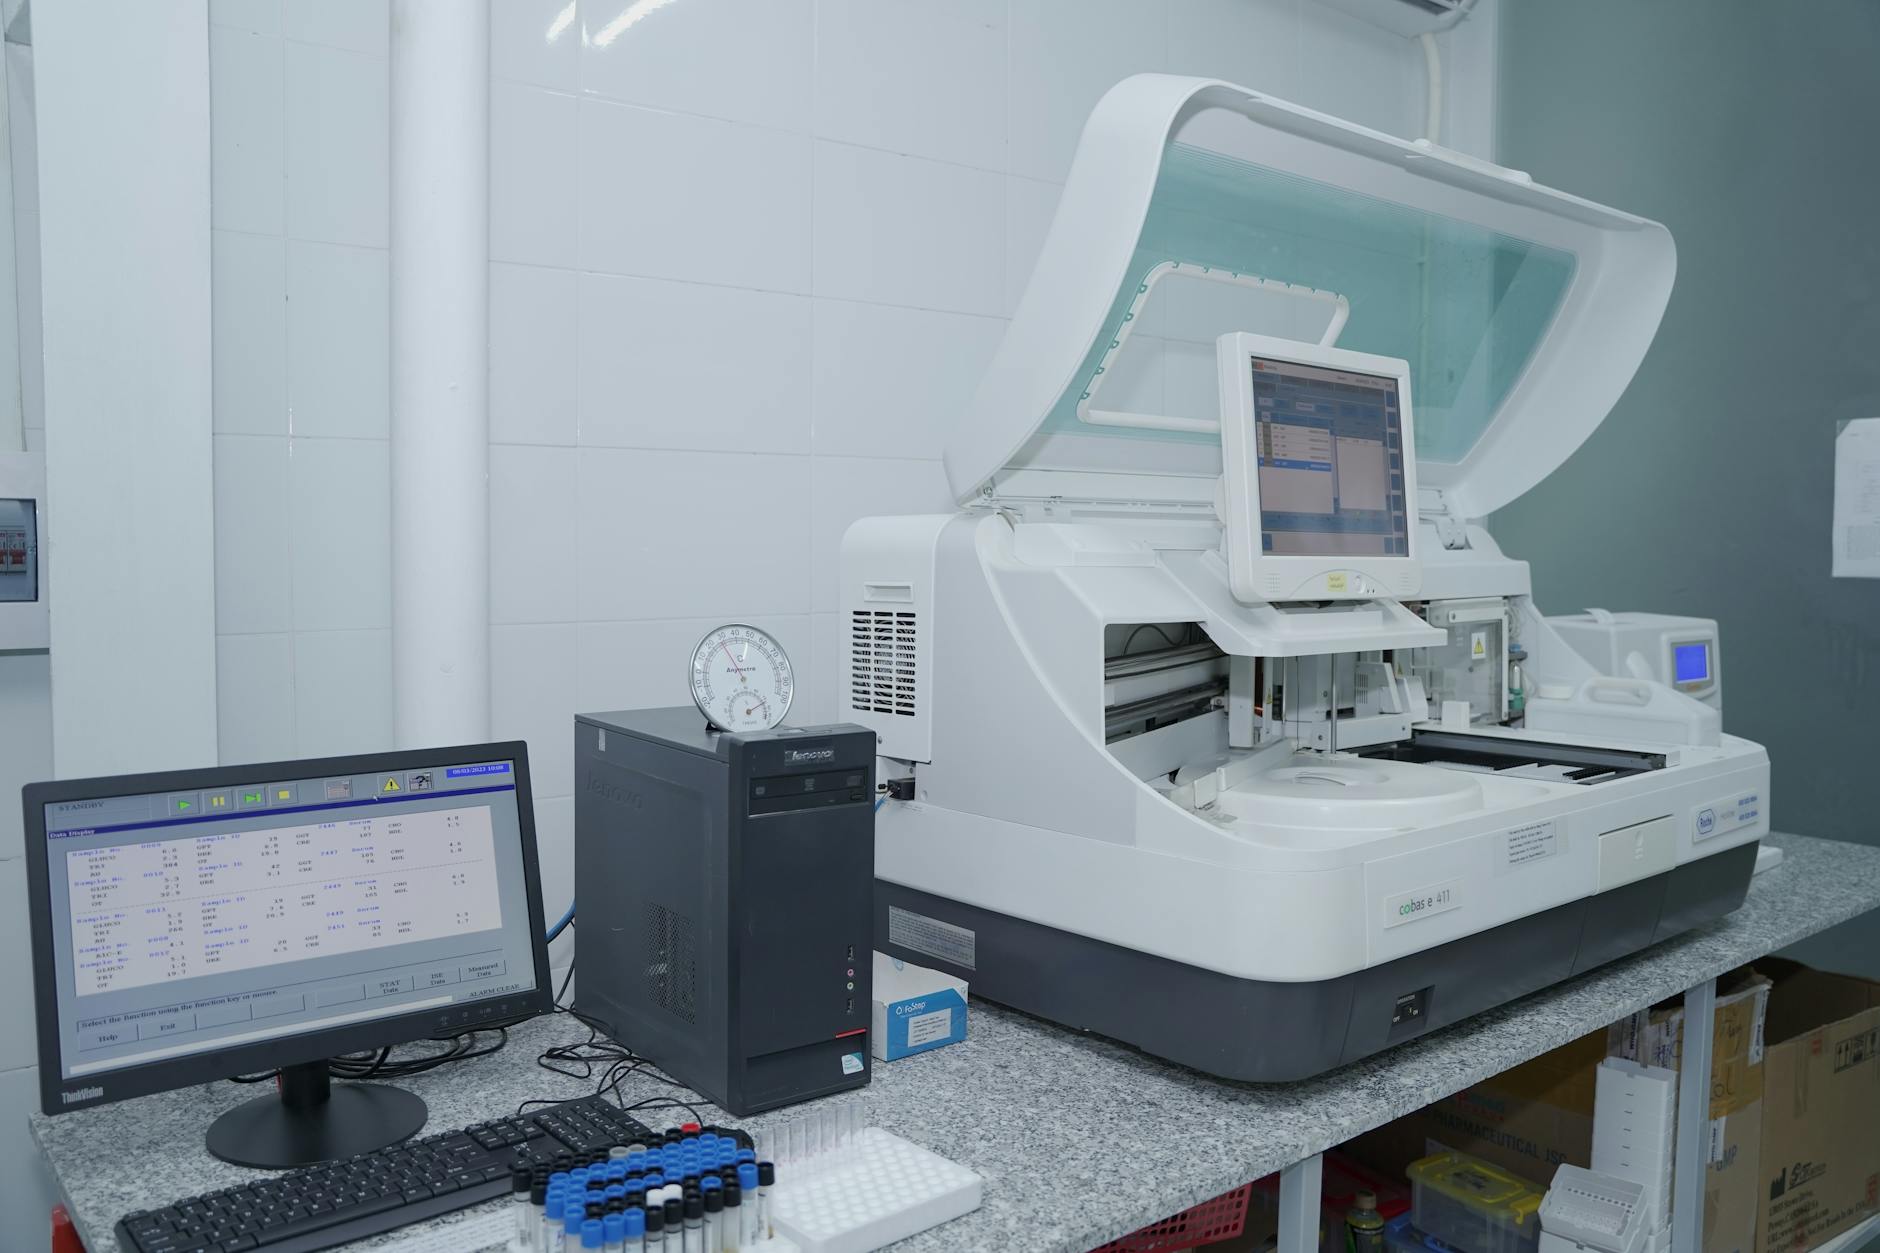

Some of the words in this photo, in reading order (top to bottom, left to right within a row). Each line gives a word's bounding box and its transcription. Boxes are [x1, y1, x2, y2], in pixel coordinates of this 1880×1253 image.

[792, 750, 833, 760] lenovo
[58, 801, 104, 811] STANDBY
[68, 829, 96, 837] Display
[1399, 899, 1425, 915] cobas
[1427, 897, 1433, 907] e
[1436, 889, 1450, 904] 411
[468, 962, 499, 973] Measured
[379, 979, 401, 988] STAT
[383, 986, 399, 994] Data
[469, 986, 495, 997] ALARM
[496, 983, 520, 993] CLEAR
[81, 1019, 107, 1028] Select
[109, 1016, 122, 1024] the
[123, 1011, 157, 1022] function
[159, 1007, 179, 1016] using
[181, 1004, 193, 1012] the
[195, 999, 226, 1009] function
[227, 996, 241, 1004] key
[160, 1022, 176, 1031] Exit
[98, 1032, 118, 1043] Help
[61, 1086, 104, 1104] ThinkVision
[1432, 1108, 1538, 1158] PHARMACEUTICAL
